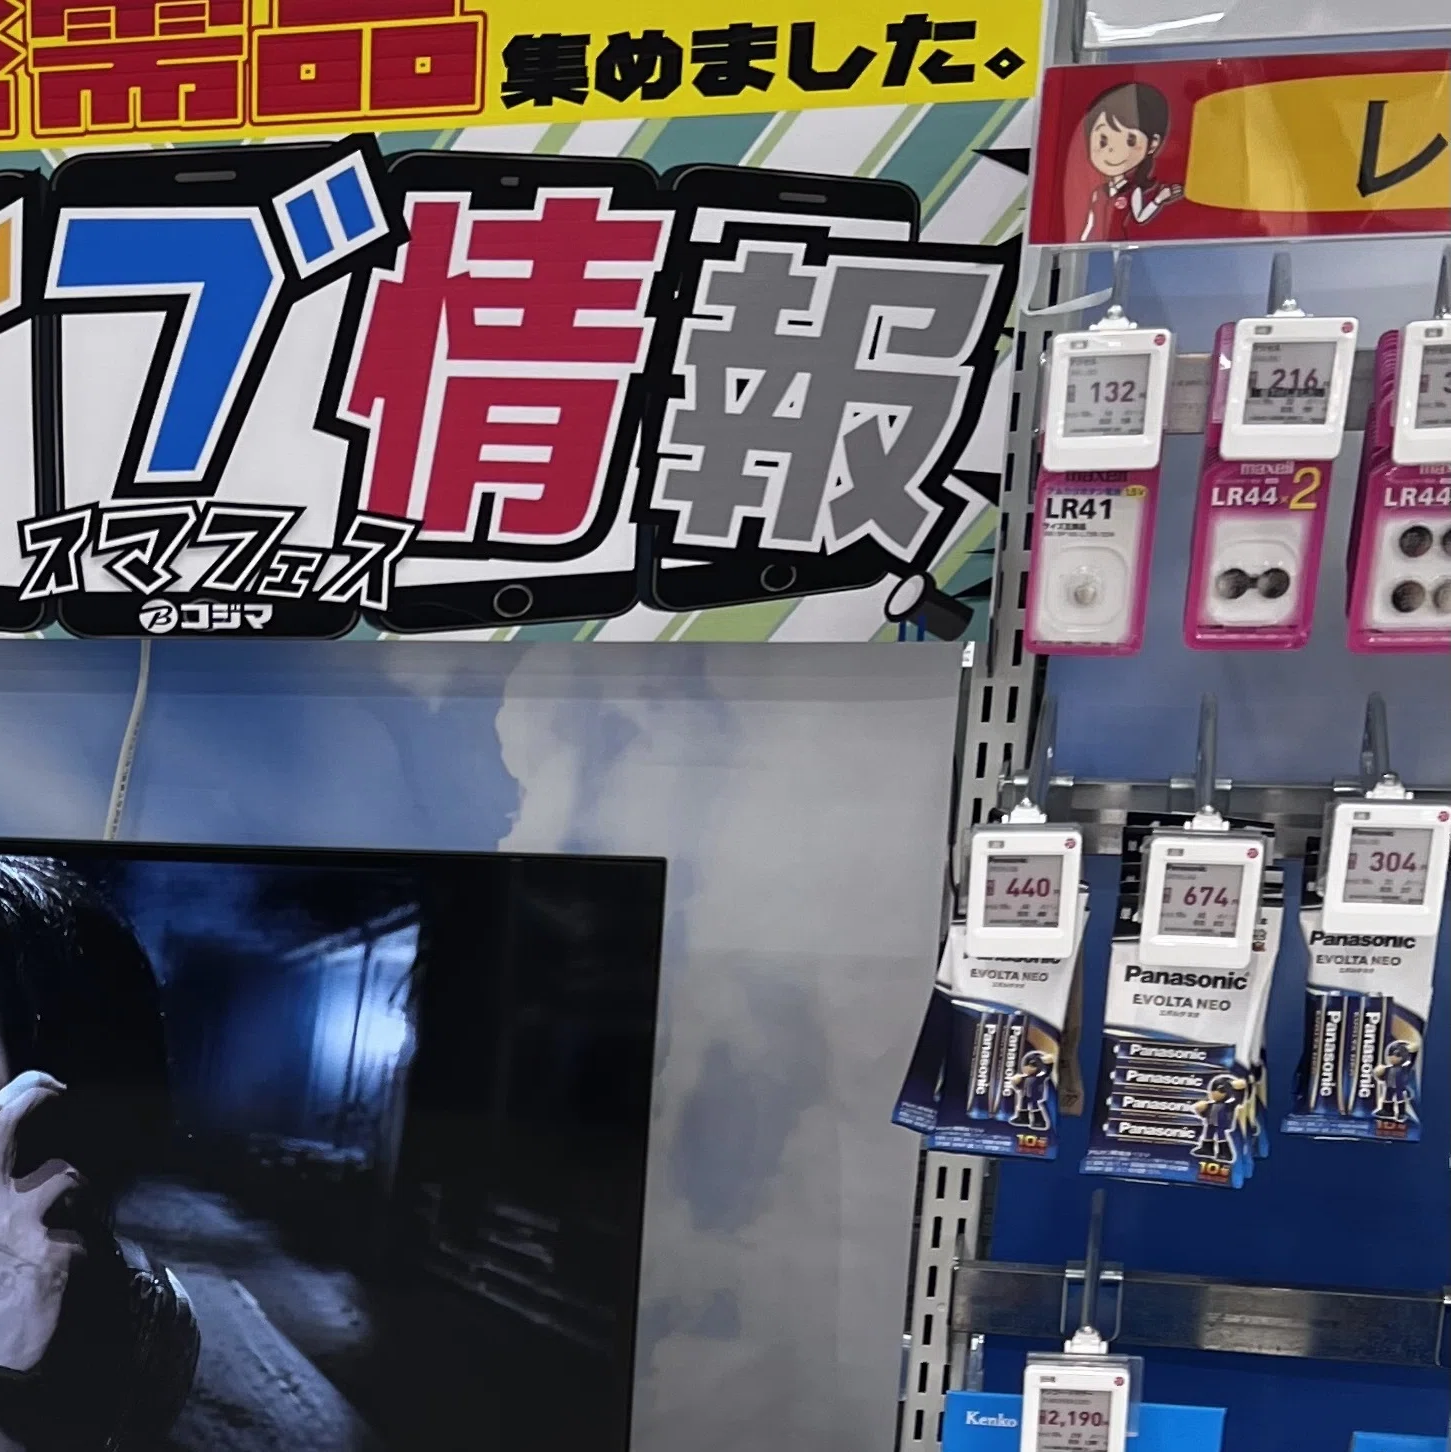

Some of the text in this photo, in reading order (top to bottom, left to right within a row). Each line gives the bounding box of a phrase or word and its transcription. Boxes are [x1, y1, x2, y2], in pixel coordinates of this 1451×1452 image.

[500, 13, 1027, 108] 集めました。
[1270, 368, 1319, 391] 216
[1090, 380, 1136, 403] 132
[1211, 486, 1278, 506] LR44
[1045, 498, 1113, 519] LR41
[18, 500, 421, 611] スマフェス
[181, 602, 272, 630] コジマ
[1369, 852, 1417, 873] 304
[1005, 877, 1051, 897] 440
[1182, 886, 1229, 907] 674
[1309, 930, 1416, 950] Panasonic
[1316, 954, 1402, 967] EVOLTA NEO
[970, 968, 1049, 982] EVOLTA NEO
[1124, 965, 1248, 991] Panasonic
[1132, 993, 1232, 1012] EVOLTA NEO
[975, 1023, 997, 1096] Panasonic
[1129, 1044, 1207, 1061] Panasonic
[1320, 1010, 1342, 1097] Panasonic
[1358, 1010, 1381, 1099] Panasonic
[1126, 1070, 1204, 1088] Panasonic
[1118, 1121, 1196, 1139] Panasonic
[965, 1410, 1018, 1428] Kenko
[1048, 1410, 1103, 1428] 2,190
